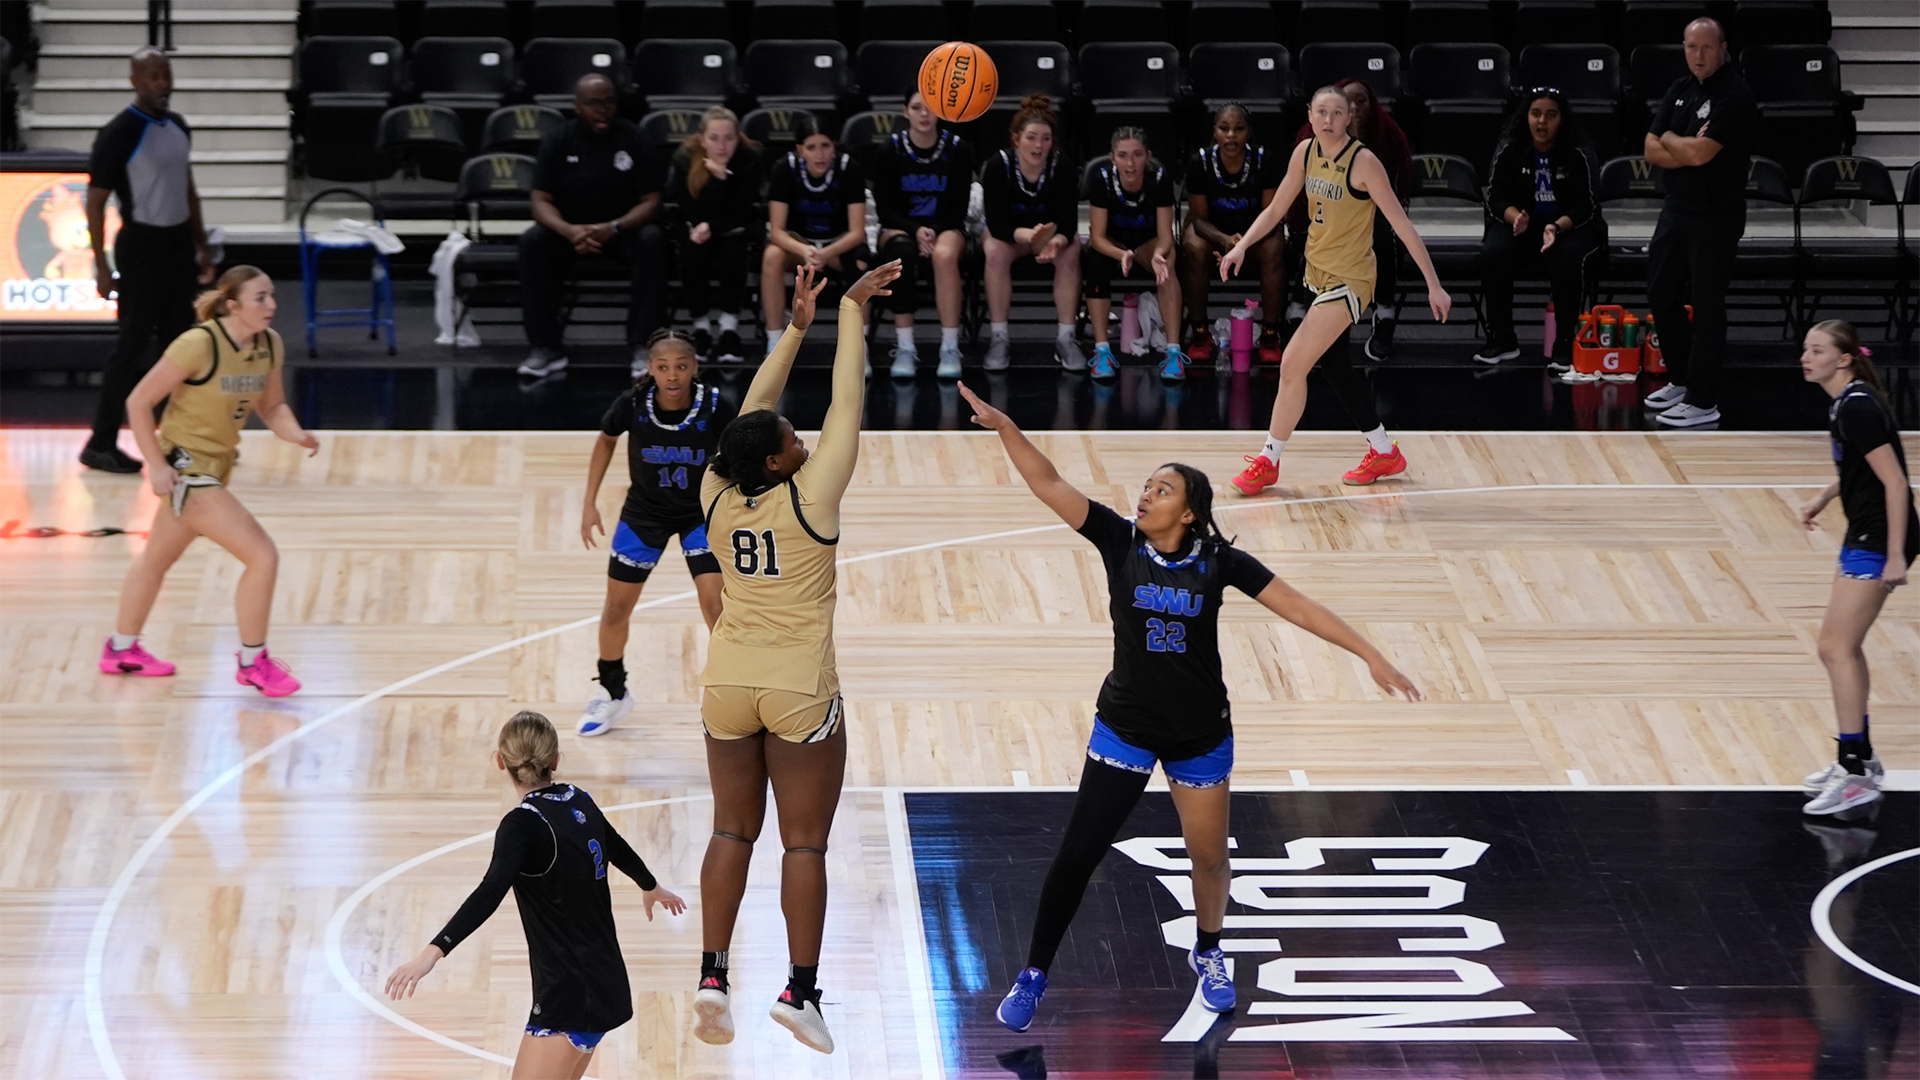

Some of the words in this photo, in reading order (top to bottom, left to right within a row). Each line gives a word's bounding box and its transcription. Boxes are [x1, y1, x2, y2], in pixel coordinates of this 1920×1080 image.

[1370, 60, 1381, 69] 10
[1591, 61, 1600, 69] 12
[1809, 62, 1819, 70] 14
[947, 55, 971, 108] Wilson
[408, 108, 433, 129] W
[514, 108, 540, 129] W
[666, 111, 690, 132] W
[768, 111, 793, 132] W
[871, 114, 897, 133] W
[490, 157, 516, 179] W
[1422, 157, 1448, 179] W
[1628, 158, 1653, 180] W
[1834, 159, 1861, 181] W
[1313, 201, 1324, 225] 2
[9, 285, 92, 304] HOTS
[1600, 333, 1611, 346] G
[1603, 352, 1619, 370] G
[641, 445, 706, 466] SWU
[657, 466, 689, 490] 14
[731, 528, 779, 578] 81
[1132, 582, 1203, 617] SWU
[1145, 617, 1187, 653] 22
[587, 838, 606, 880] 2
